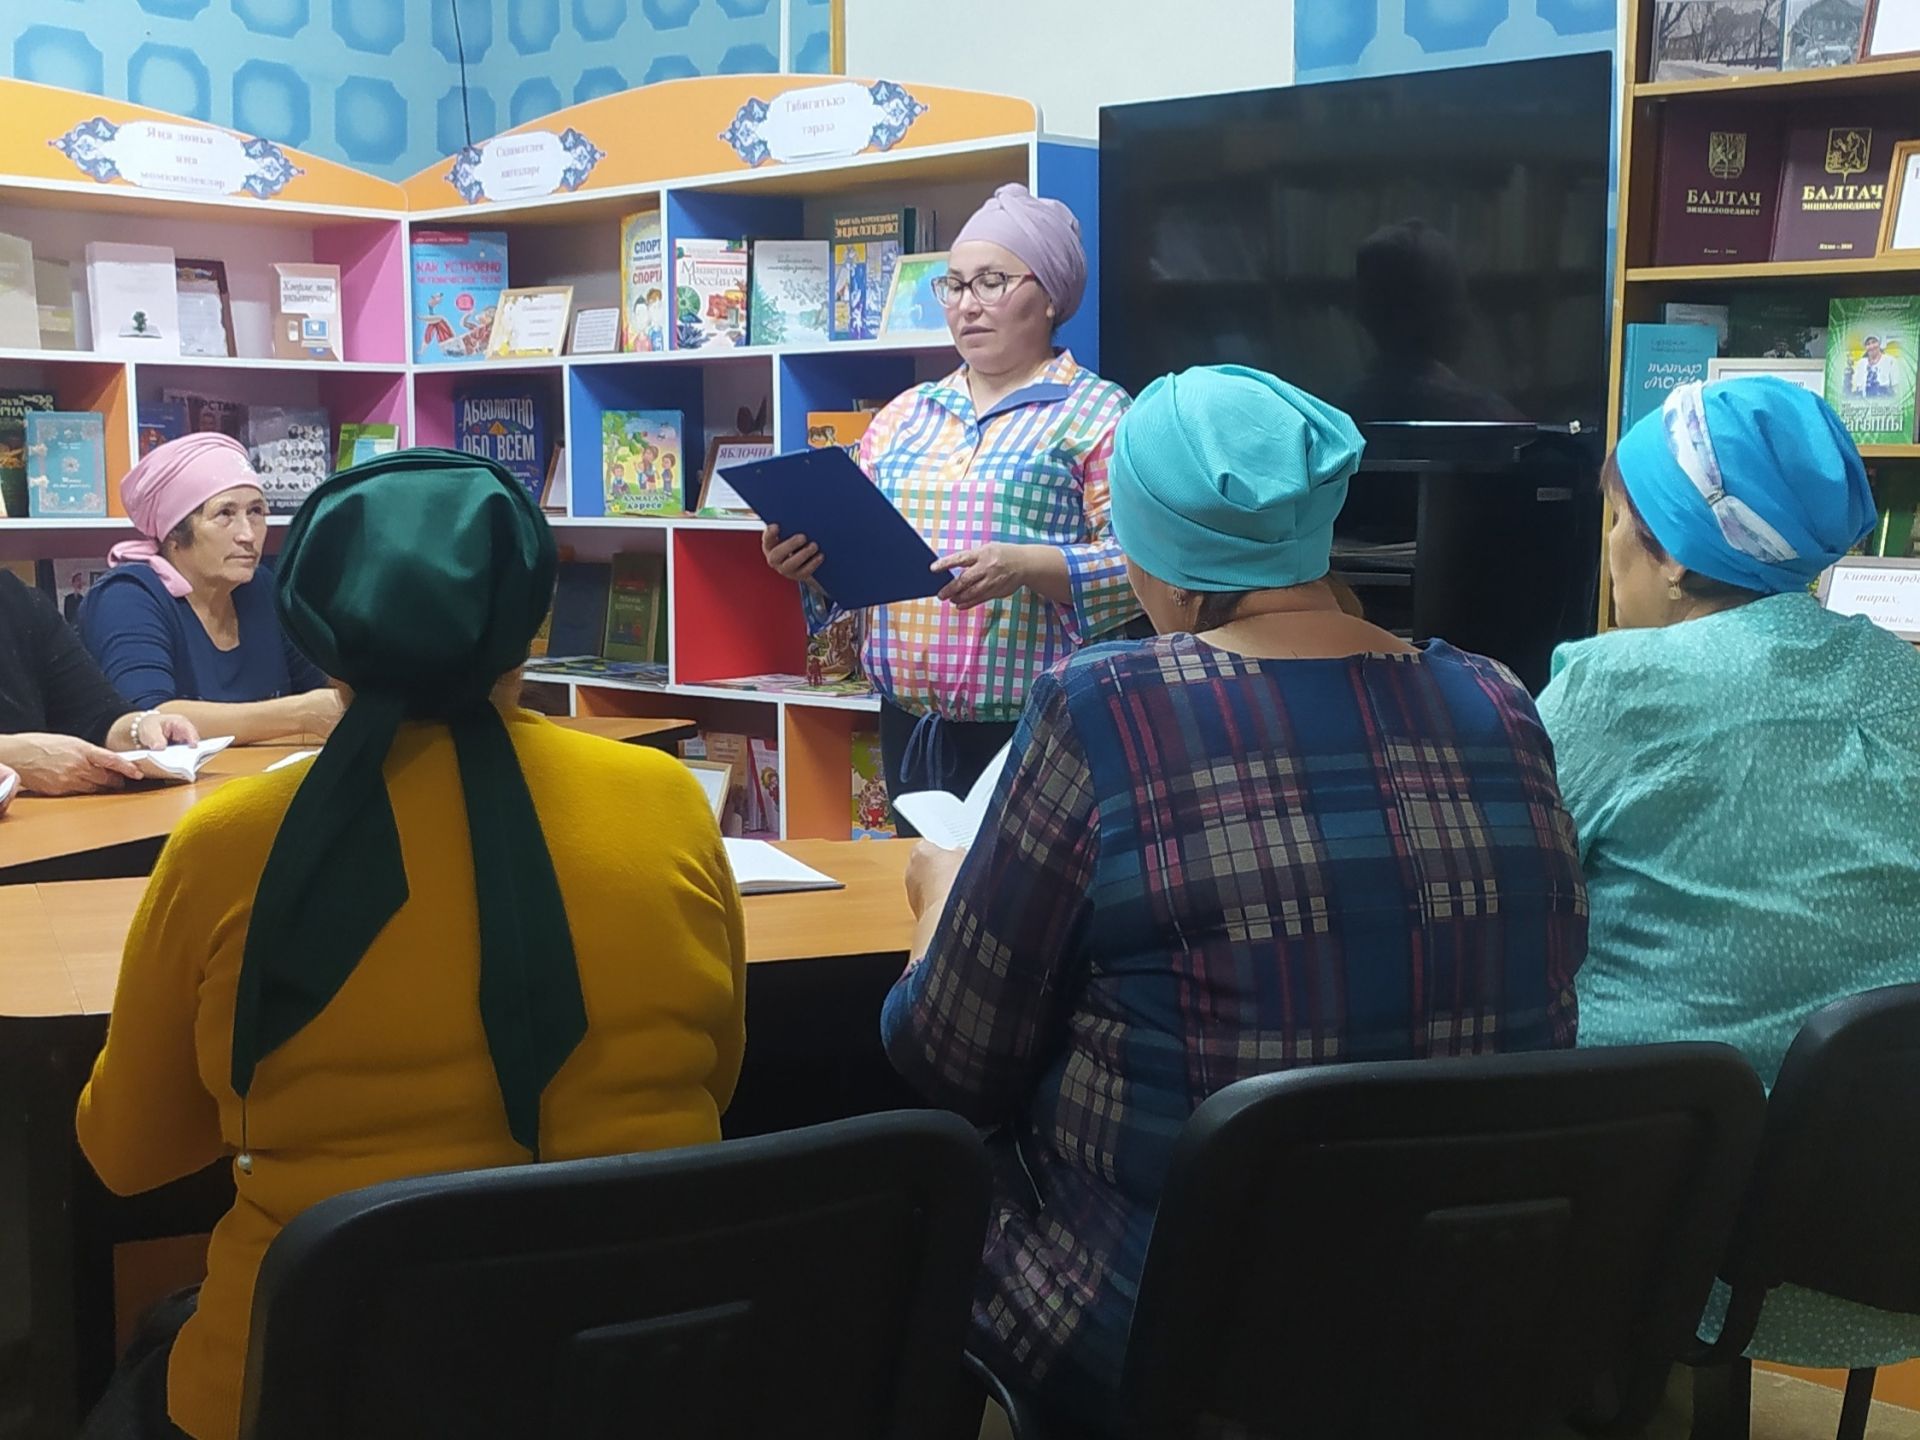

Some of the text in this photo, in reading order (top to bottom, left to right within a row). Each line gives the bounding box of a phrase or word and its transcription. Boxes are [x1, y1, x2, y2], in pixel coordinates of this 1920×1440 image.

[1687, 189, 1761, 206] БАЛТАЧ
[1801, 184, 1884, 200] БАЛТАЧ
[681, 261, 743, 278] Минералы
[462, 399, 534, 431] АБСОЛЮТНО
[498, 431, 535, 462] ВСЁМ
